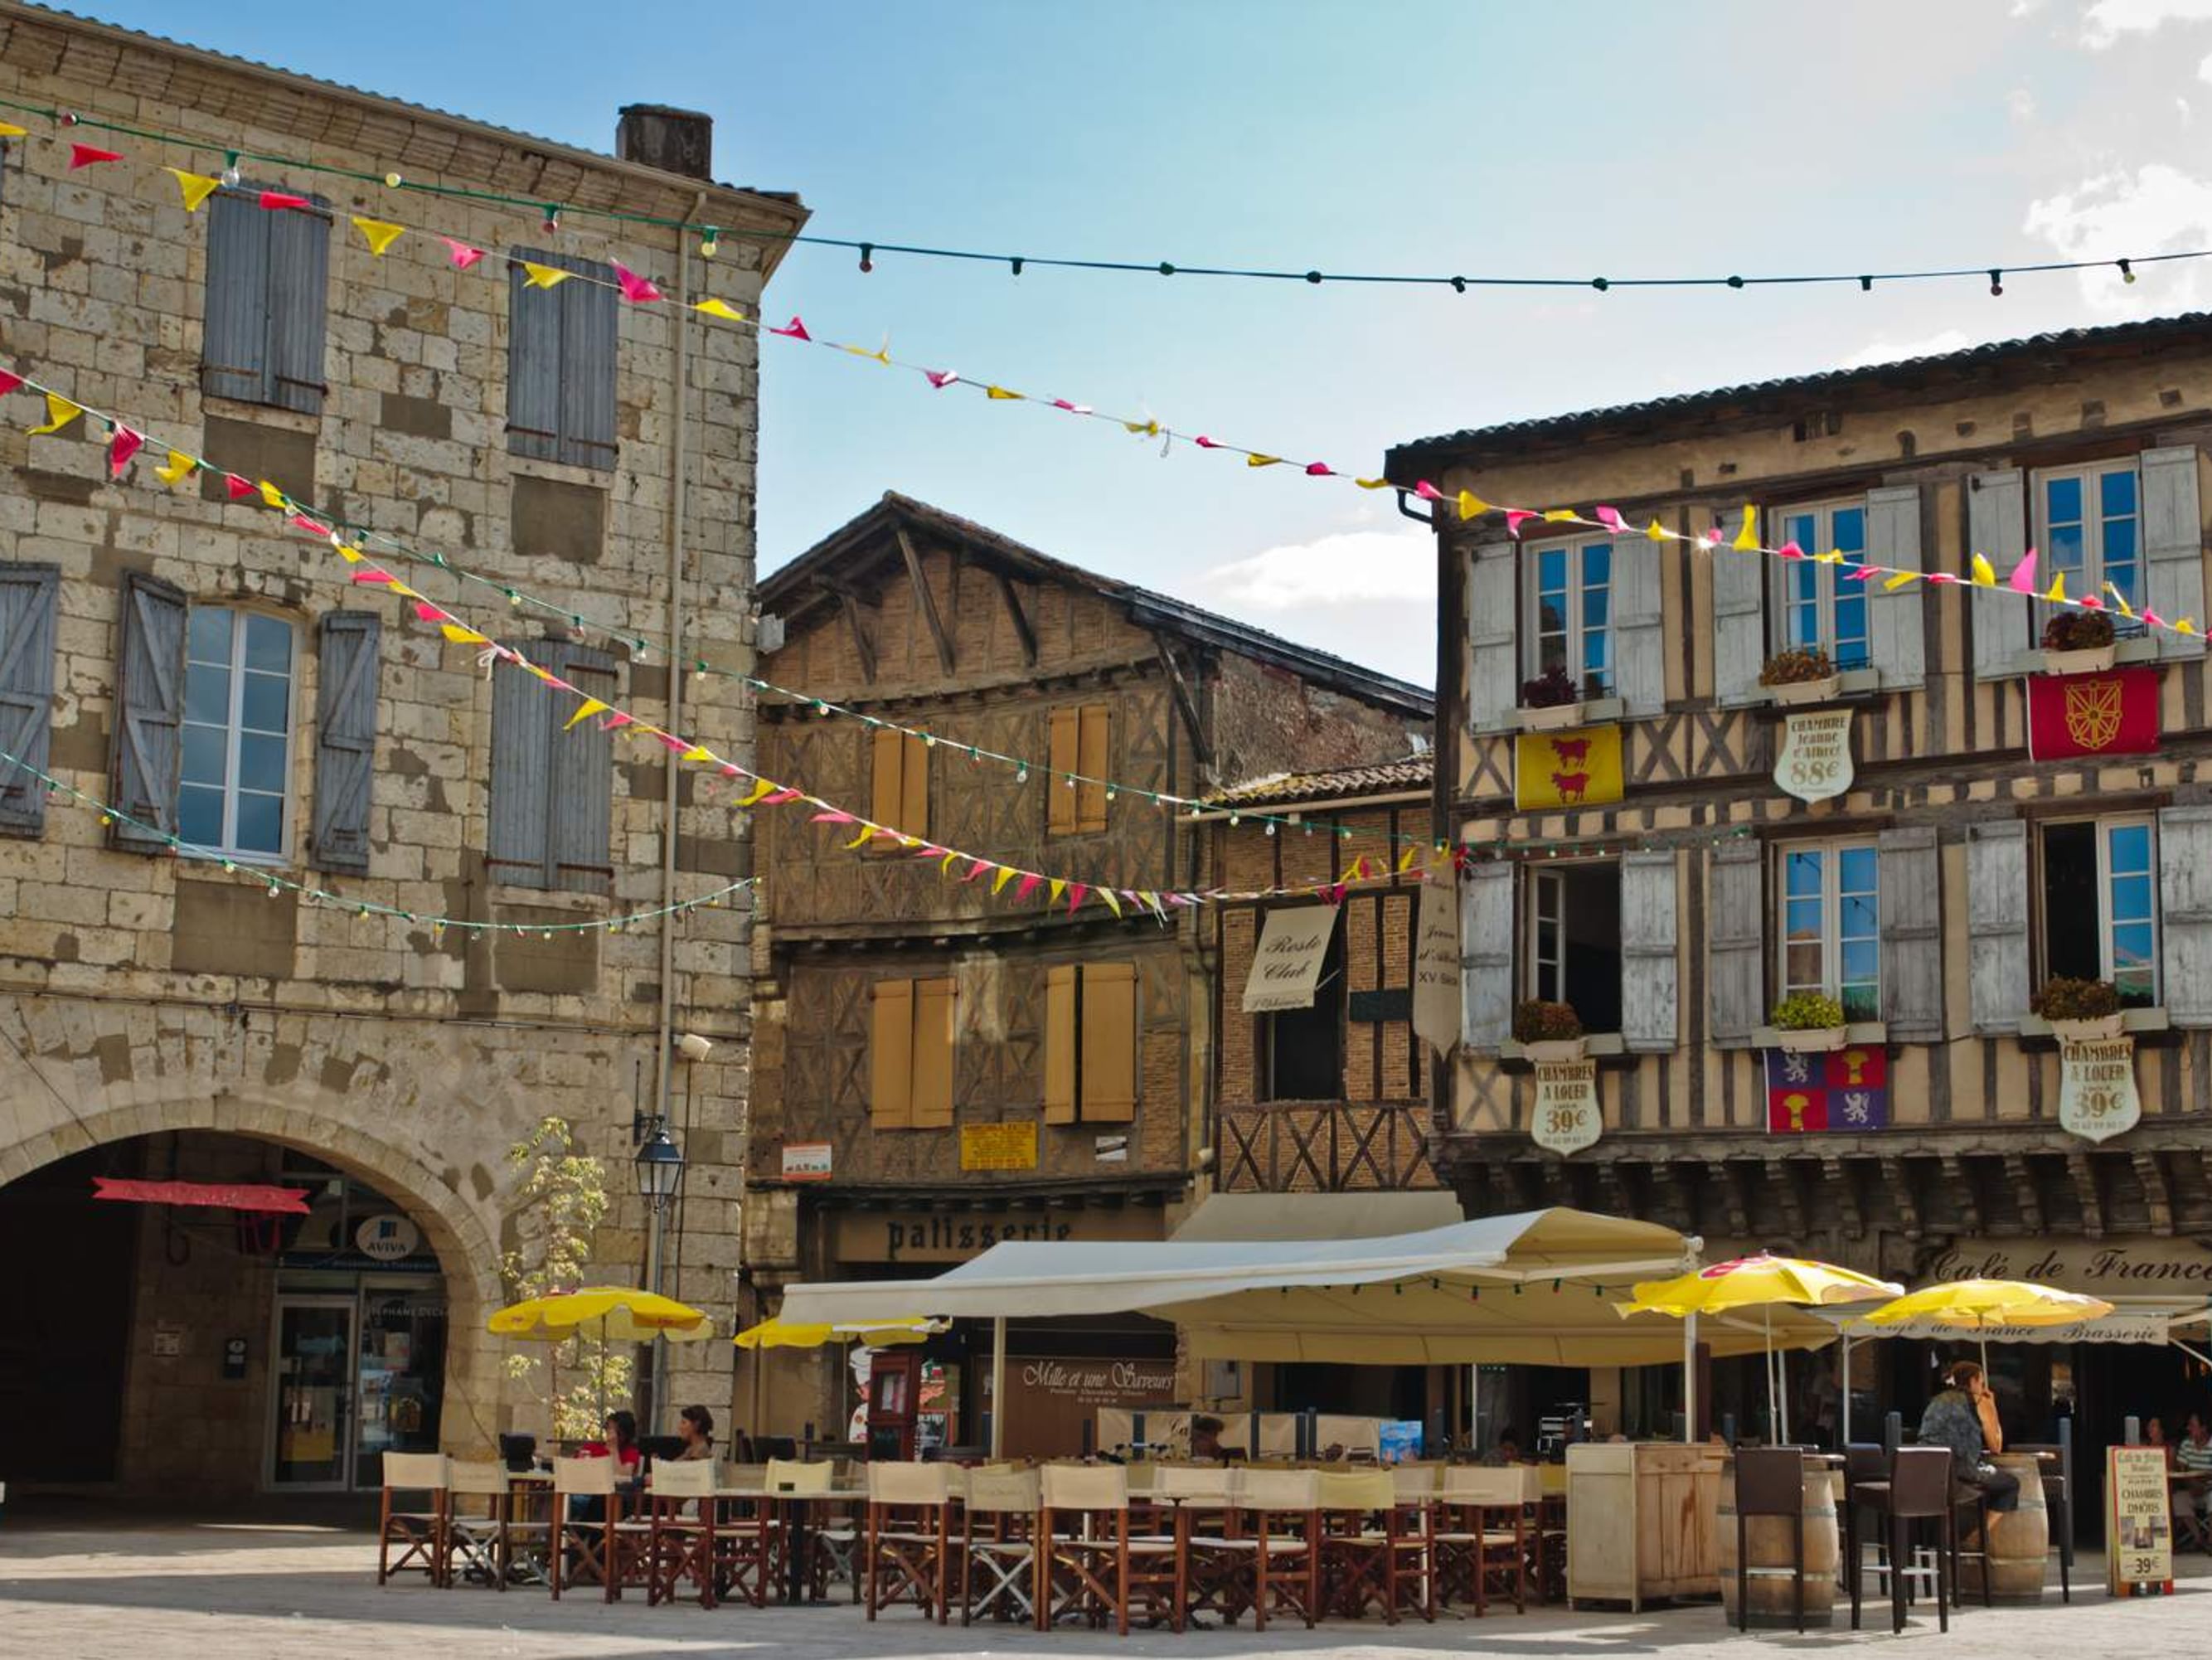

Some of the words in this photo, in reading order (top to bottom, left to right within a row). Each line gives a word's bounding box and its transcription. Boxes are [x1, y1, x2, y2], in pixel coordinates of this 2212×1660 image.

[1792, 716, 1846, 732] CHAMBRE
[1797, 731, 1838, 745] Jeanne
[1791, 760, 1840, 785] 88€
[1265, 934, 1322, 954] Resto
[1264, 960, 1312, 979] Club
[1419, 971, 1437, 983] XV
[2064, 1044, 2132, 1061] CHAMBRES
[1537, 1065, 1594, 1082] CHAMBRES
[2084, 1064, 2125, 1082] LOUER
[1554, 1084, 1588, 1100] LOUER
[2074, 1091, 2126, 1119] 39€
[1545, 1109, 1589, 1134] 39€
[366, 1241, 409, 1253] AVIVA
[1934, 1245, 2009, 1281] Café
[2025, 1250, 2065, 1280] de
[2084, 1248, 2212, 1281] France
[2062, 1322, 2158, 1341] Brasserie
[1022, 1361, 1068, 1386] Mille
[1068, 1371, 1081, 1387] et
[1083, 1373, 1107, 1388] une
[1111, 1361, 1174, 1391] Saveurs
[2122, 1489, 2163, 1499] CHAMBRES
